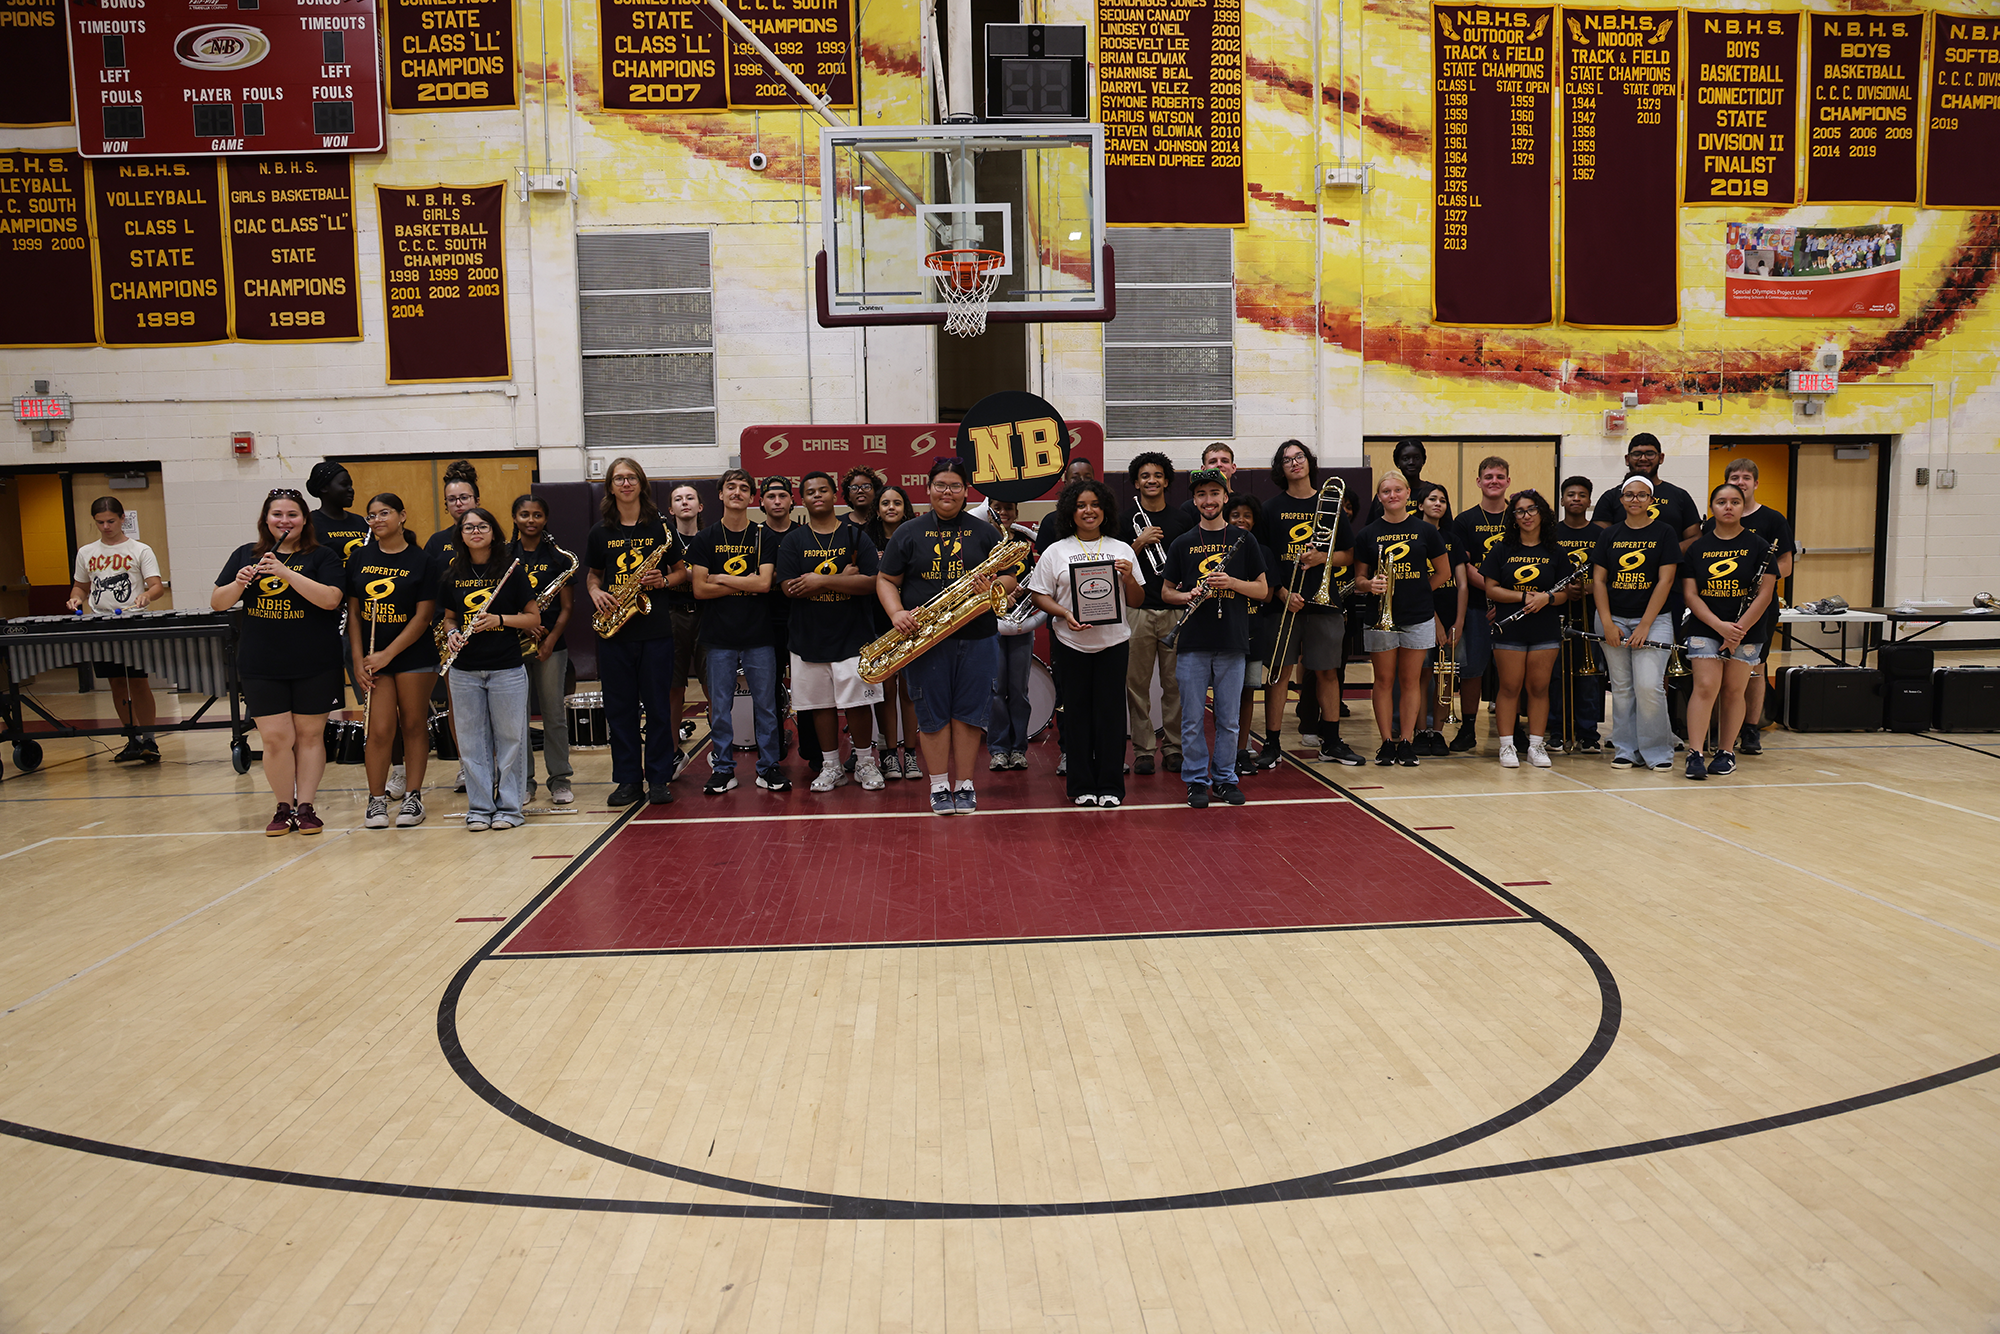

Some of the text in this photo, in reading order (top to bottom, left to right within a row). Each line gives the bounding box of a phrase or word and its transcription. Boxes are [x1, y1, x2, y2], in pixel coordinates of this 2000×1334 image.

[300, 16, 365, 29] TIMEOUTS
[422, 10, 480, 29] STATE
[632, 11, 693, 29] STATE
[1100, 9, 1239, 22] SEQUAN CANADY 1999
[79, 20, 145, 33] TIMEOUTS
[1101, 22, 1240, 37] LINDSEY O'NEIL 2000
[1464, 28, 1524, 44] OUTDOOR
[1598, 32, 1643, 47] INDOOR
[403, 34, 465, 53] CLASS
[615, 36, 676, 53] CLASS
[774, 42, 846, 54] 1992 1993
[1100, 37, 1240, 51] ROOSEVELT LEE 2002
[1727, 41, 1759, 58] BOYS
[1444, 45, 1544, 61] TRACK & FIELD
[1572, 49, 1670, 64] TRACK & FIELD
[1841, 44, 1890, 58] BOYS
[1101, 52, 1240, 66] BRIAN GLOWIAK 2004
[322, 65, 351, 78] LEFT
[402, 56, 504, 77] CHAMPIONS
[613, 60, 715, 78] CHAMPIONS
[818, 62, 846, 74] 2001
[1101, 67, 1241, 80] SHARNISE BEAL 2006
[1444, 62, 1544, 78] STATE CHAMPIONS
[1571, 66, 1670, 81] STATE CHAMPIONS
[1701, 64, 1783, 82] BASKETBALL
[1824, 64, 1905, 79] BASKETBALL
[100, 70, 130, 82] LEFT
[313, 86, 352, 98] FOULS
[418, 82, 488, 101] 2006
[630, 84, 700, 102] 2007
[756, 84, 786, 96] 2002
[1101, 81, 1241, 95] DARRYL VELEZ 2006
[1438, 79, 1549, 93] CLASS L STATE OPEN
[1858, 86, 1912, 100] DIVISIONAL
[102, 90, 142, 103] FOULS
[184, 87, 282, 101] PLAYER FOULS
[1444, 94, 1534, 107] 1958 1959
[1698, 87, 1784, 105] CONNECTICUT
[1102, 96, 1240, 110] SYMONE ROBERTS 2009
[1572, 97, 1660, 110] 1944 1979
[1103, 110, 1240, 124] DARIUS WATSON 2010
[1572, 112, 1660, 124] 1947 2010
[1717, 110, 1767, 127] STATE
[1820, 106, 1906, 121] CHAMPIONS
[1932, 118, 1958, 130] 2019
[1152, 125, 1240, 138] GLOWIAK 2010
[1813, 127, 1912, 139] 2005 2006 2009
[103, 141, 128, 152] WON
[212, 139, 244, 150] GAME
[323, 136, 348, 147] WON
[1154, 140, 1239, 152] JOHNSON 2014
[1444, 137, 1534, 150] 1961 1977
[1698, 134, 1784, 151] DIVISION II
[1813, 146, 1876, 157] 2014 2019
[1160, 154, 1240, 167] DUPREE 2020
[1705, 156, 1776, 173] FINALIST
[1444, 180, 1467, 192] 1975
[1711, 179, 1768, 196] 2019
[107, 189, 206, 206] VOLLEYBALL
[231, 188, 349, 203] GIRLS BASKETBALL
[1438, 194, 1482, 207] CLASS LL
[29, 198, 76, 213] SOUTH
[423, 208, 460, 220] GIRLS
[125, 219, 194, 235] CLASS L
[234, 219, 266, 233] CIAC
[272, 217, 318, 232] CLASS
[395, 223, 488, 236] BASKETBALL
[12, 237, 85, 250] 1999 2000
[445, 238, 486, 250] SOUTH
[1444, 238, 1466, 250] 2013
[130, 248, 194, 267] STATE
[272, 248, 316, 263] STATE
[404, 253, 483, 266] CHAMPIONS
[390, 268, 498, 282] 1998 1999 2000
[110, 279, 217, 300] CHAMPIONS
[244, 278, 346, 296] CHAMPIONS
[391, 284, 500, 300] 2001 2002 2003
[392, 304, 424, 318] 2004
[137, 312, 195, 327] 1999
[270, 311, 325, 326] 1998
[1799, 375, 1818, 390] EXIT
[21, 399, 44, 417] EXIT
[802, 439, 849, 451] CANES
[968, 417, 1064, 484] NB
[1377, 534, 1409, 542] PROPERTY
[1189, 545, 1226, 554] PROPERTY
[1702, 550, 1739, 558] PROPERTY
[361, 565, 399, 576] PROPERTY
[1405, 571, 1420, 579] BAND
[1617, 572, 1645, 582] NBHS
[1707, 580, 1739, 589] NBHS
[257, 598, 291, 610] NBHS
[248, 608, 304, 619] MARCHING BAND
[388, 614, 407, 623] BAND
